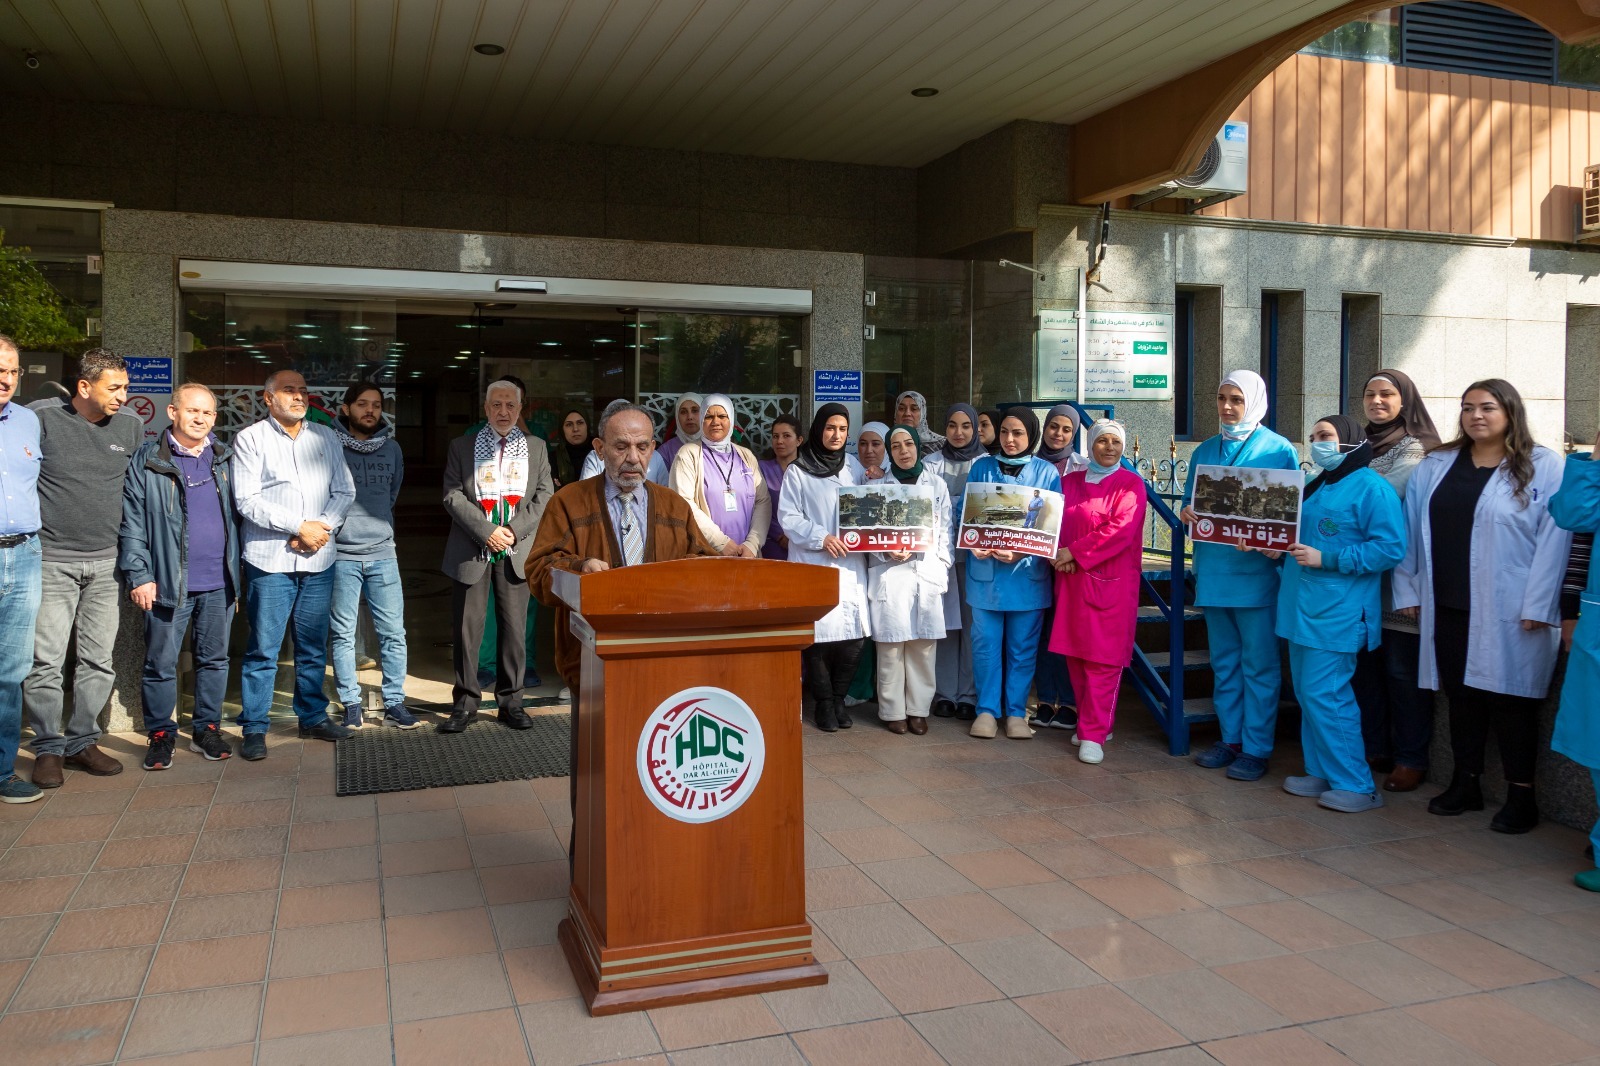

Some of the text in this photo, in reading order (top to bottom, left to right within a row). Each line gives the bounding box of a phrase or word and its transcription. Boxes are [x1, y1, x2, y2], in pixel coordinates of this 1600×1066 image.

[131, 360, 142, 370] دار
[818, 372, 859, 382] مستشفى دار الشفاء
[868, 531, 899, 549] تباد
[984, 529, 1053, 545] استهداف المراكز الطبية
[1222, 524, 1289, 547] غزة تباد
[980, 538, 1052, 555] والمستشفيات جرائم حرب
[675, 713, 745, 770] HDC
[692, 761, 729, 771] HÔPITAL
[701, 767, 739, 777] AL-CHIFAE
